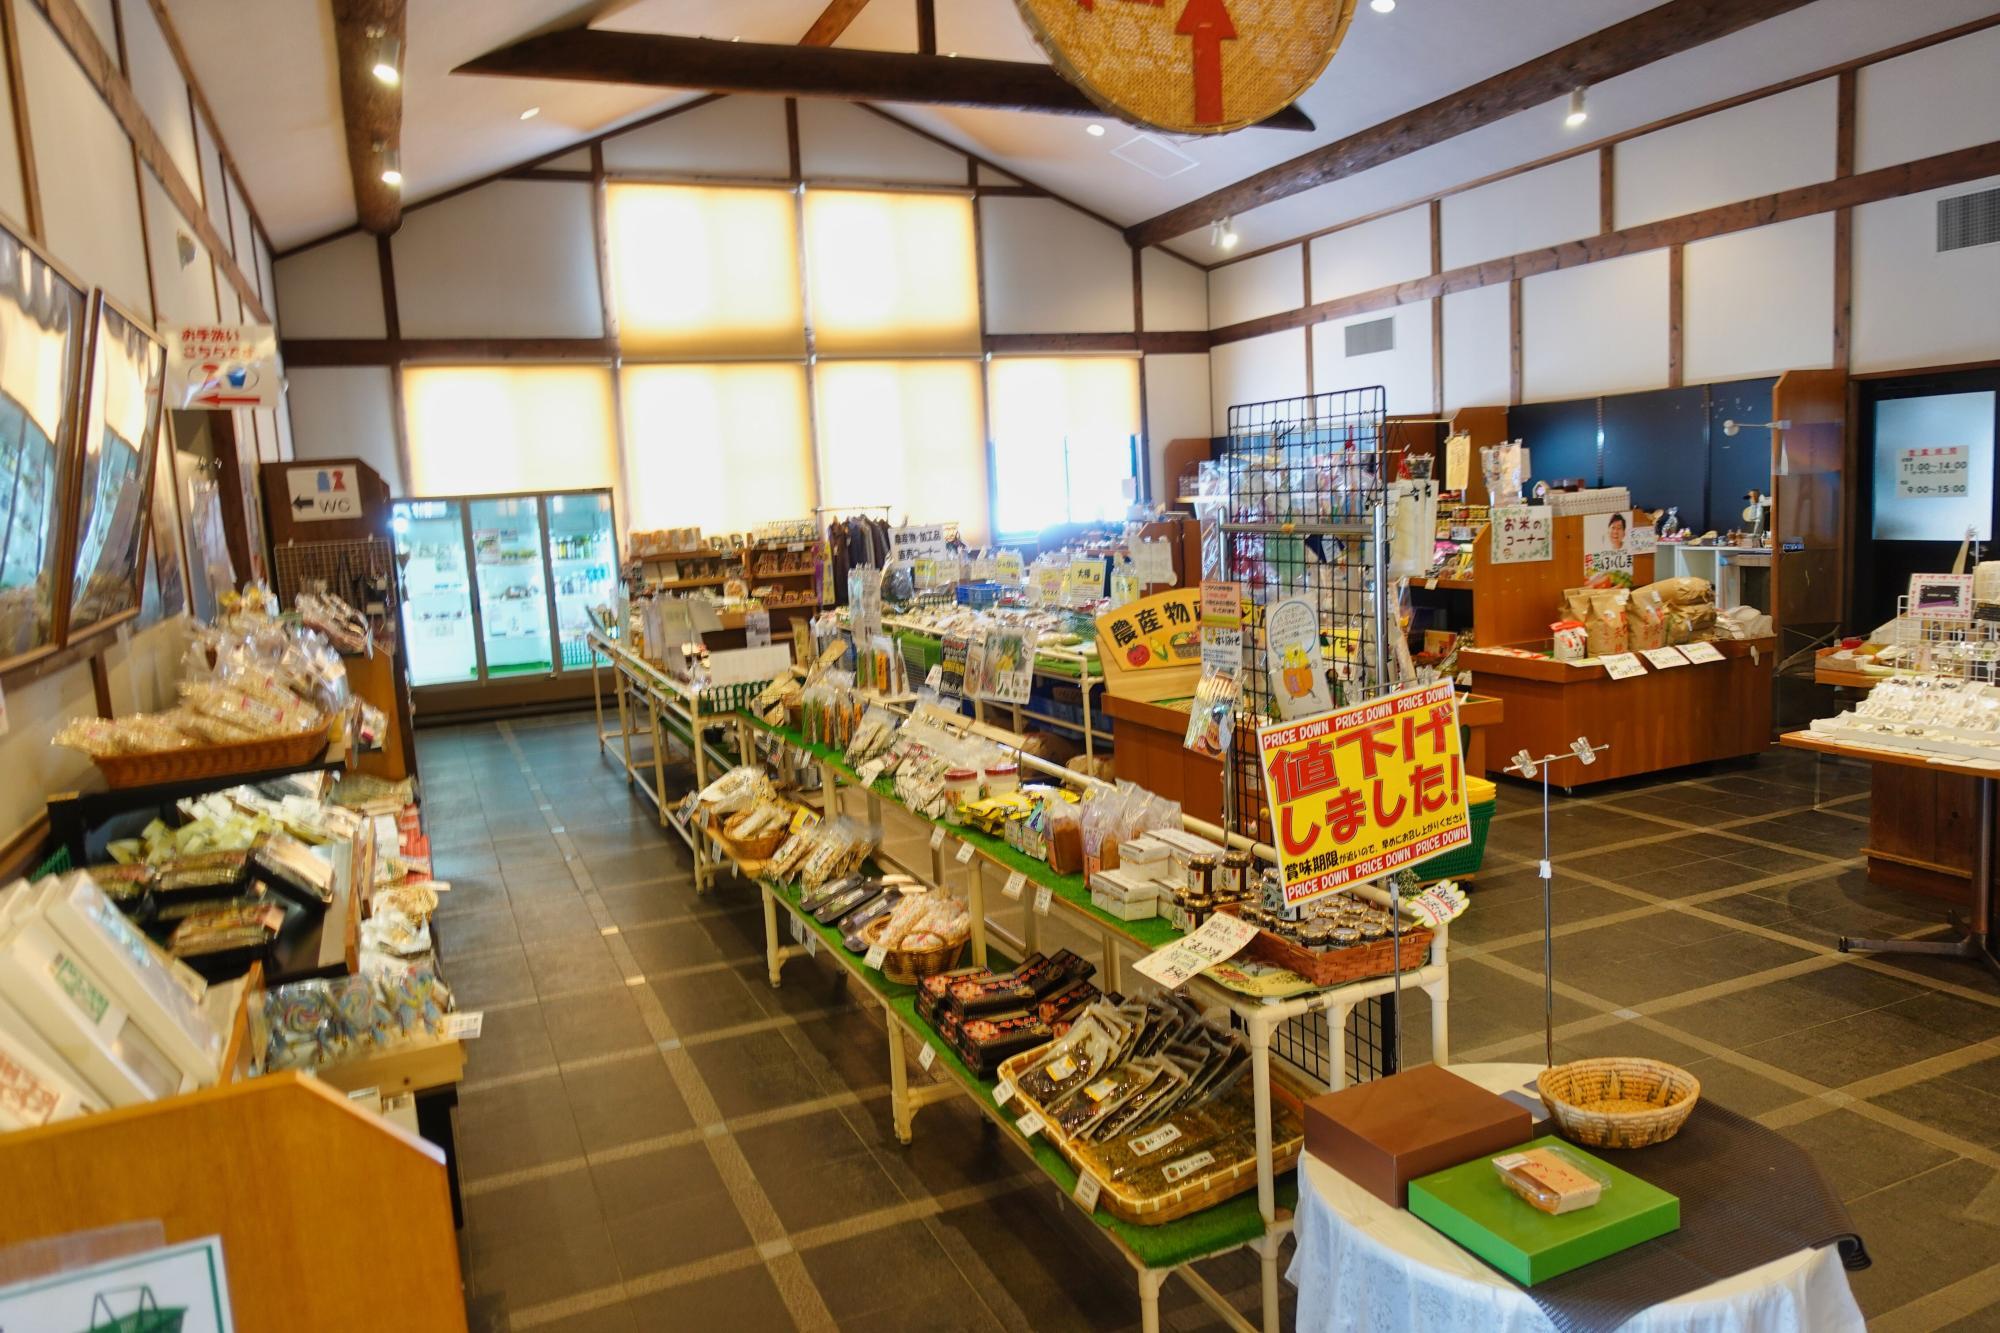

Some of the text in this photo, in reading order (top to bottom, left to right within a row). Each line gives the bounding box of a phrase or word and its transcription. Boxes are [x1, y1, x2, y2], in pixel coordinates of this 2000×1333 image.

[319, 498, 351, 514] WC
[1504, 516, 1542, 531] お米の
[1506, 536, 1546, 547] コーナー
[1264, 686, 1451, 748] PRICE DOWN PRICE DOWN PRICE DOWN
[1268, 703, 1453, 805] 値下げ
[1281, 754, 1460, 856] しました!
[1288, 826, 1468, 899] PRICE DOWN PRICE DOWN PRICE DOWN
